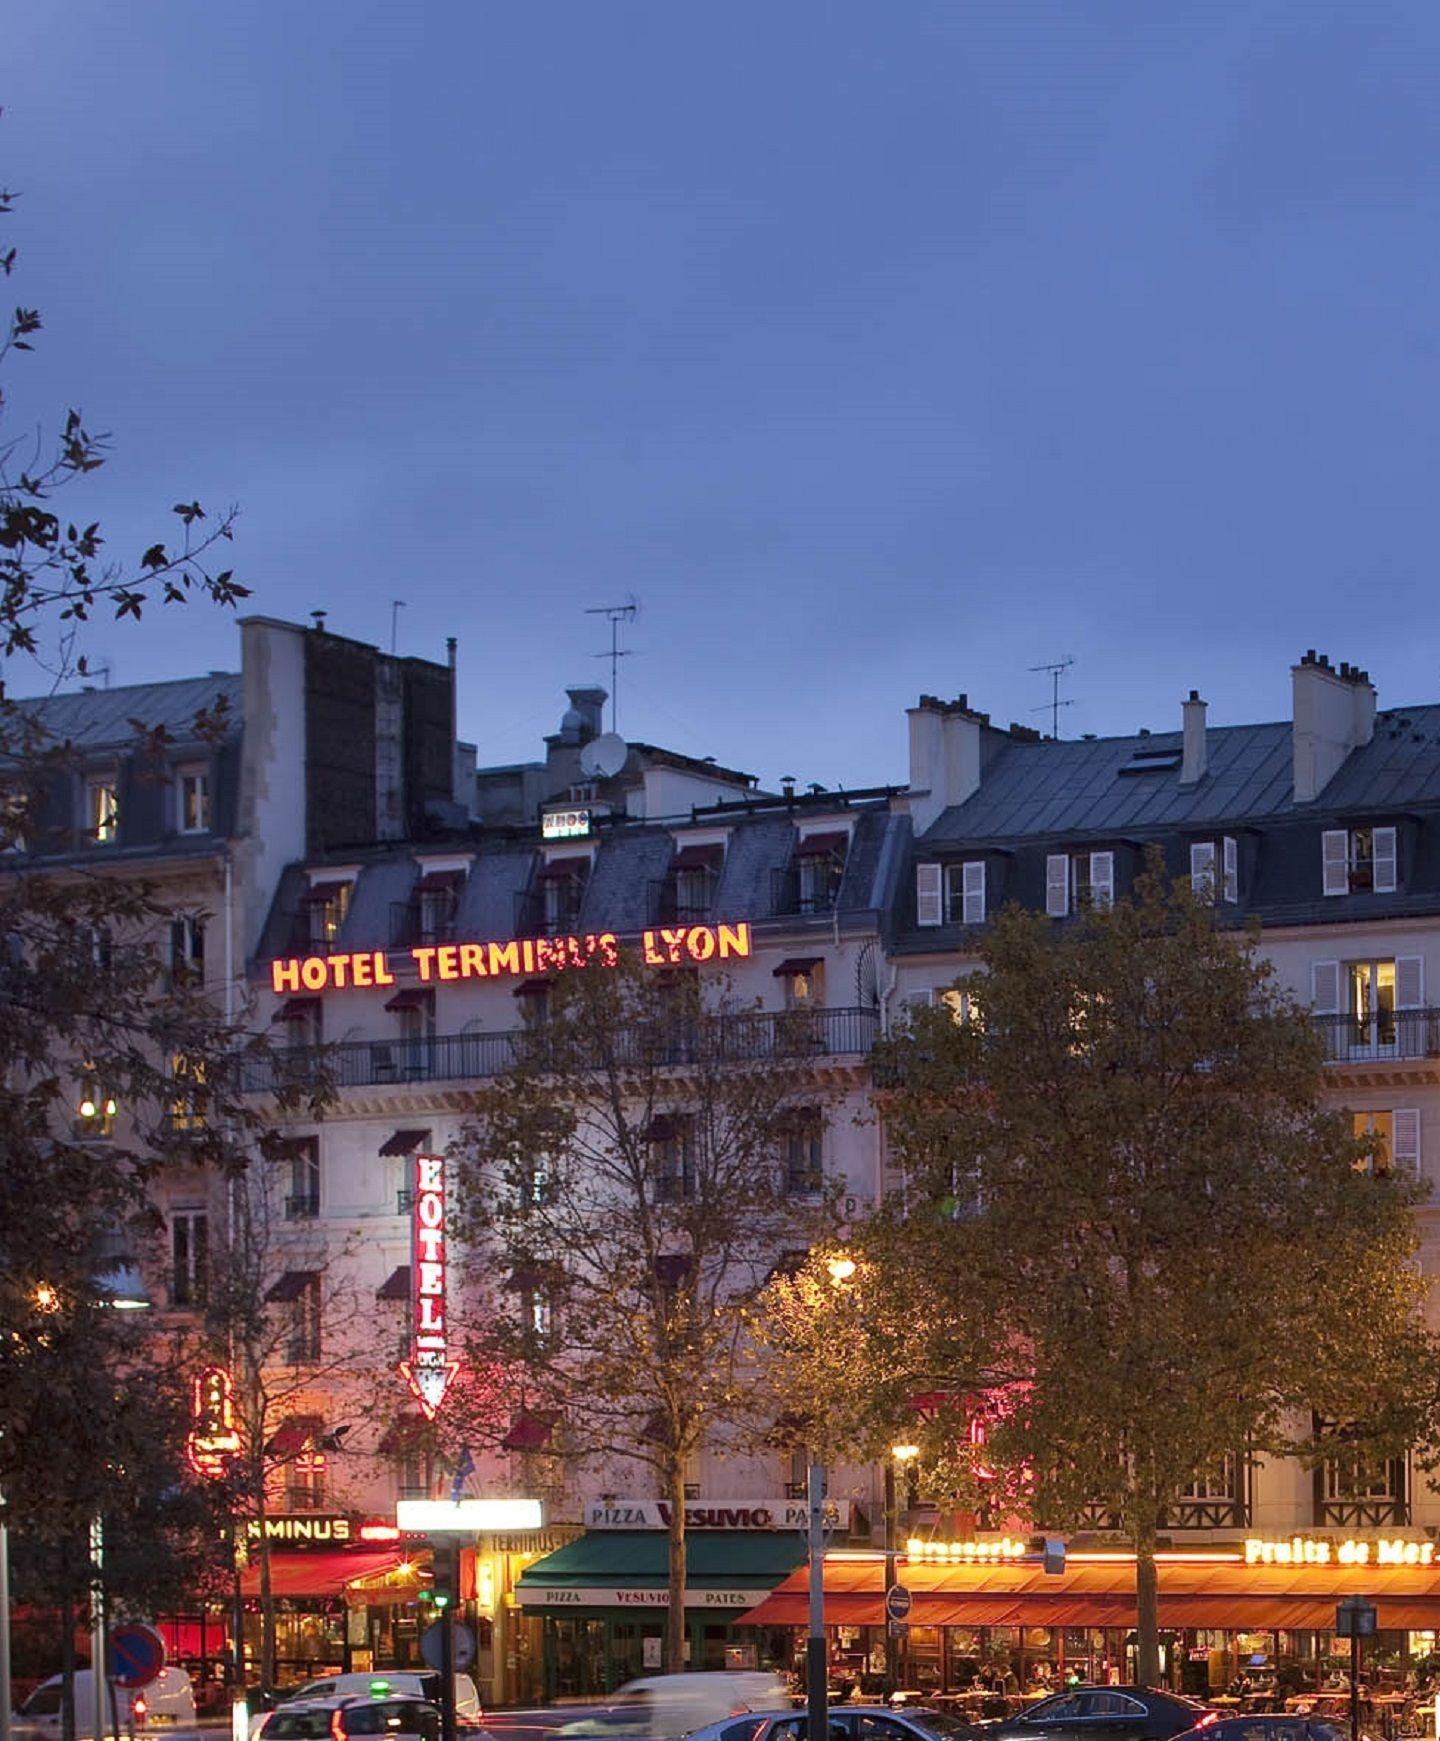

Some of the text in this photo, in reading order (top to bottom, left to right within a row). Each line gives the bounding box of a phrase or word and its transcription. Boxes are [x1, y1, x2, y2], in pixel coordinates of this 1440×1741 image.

[272, 951, 395, 993] HOTEL
[642, 922, 750, 964] LYON
[417, 1157, 443, 1332] HOTEL
[592, 1508, 647, 1524] PIZZA
[1244, 1537, 1436, 1564] Fruits de Mer
[545, 1591, 582, 1602] PIZZA
